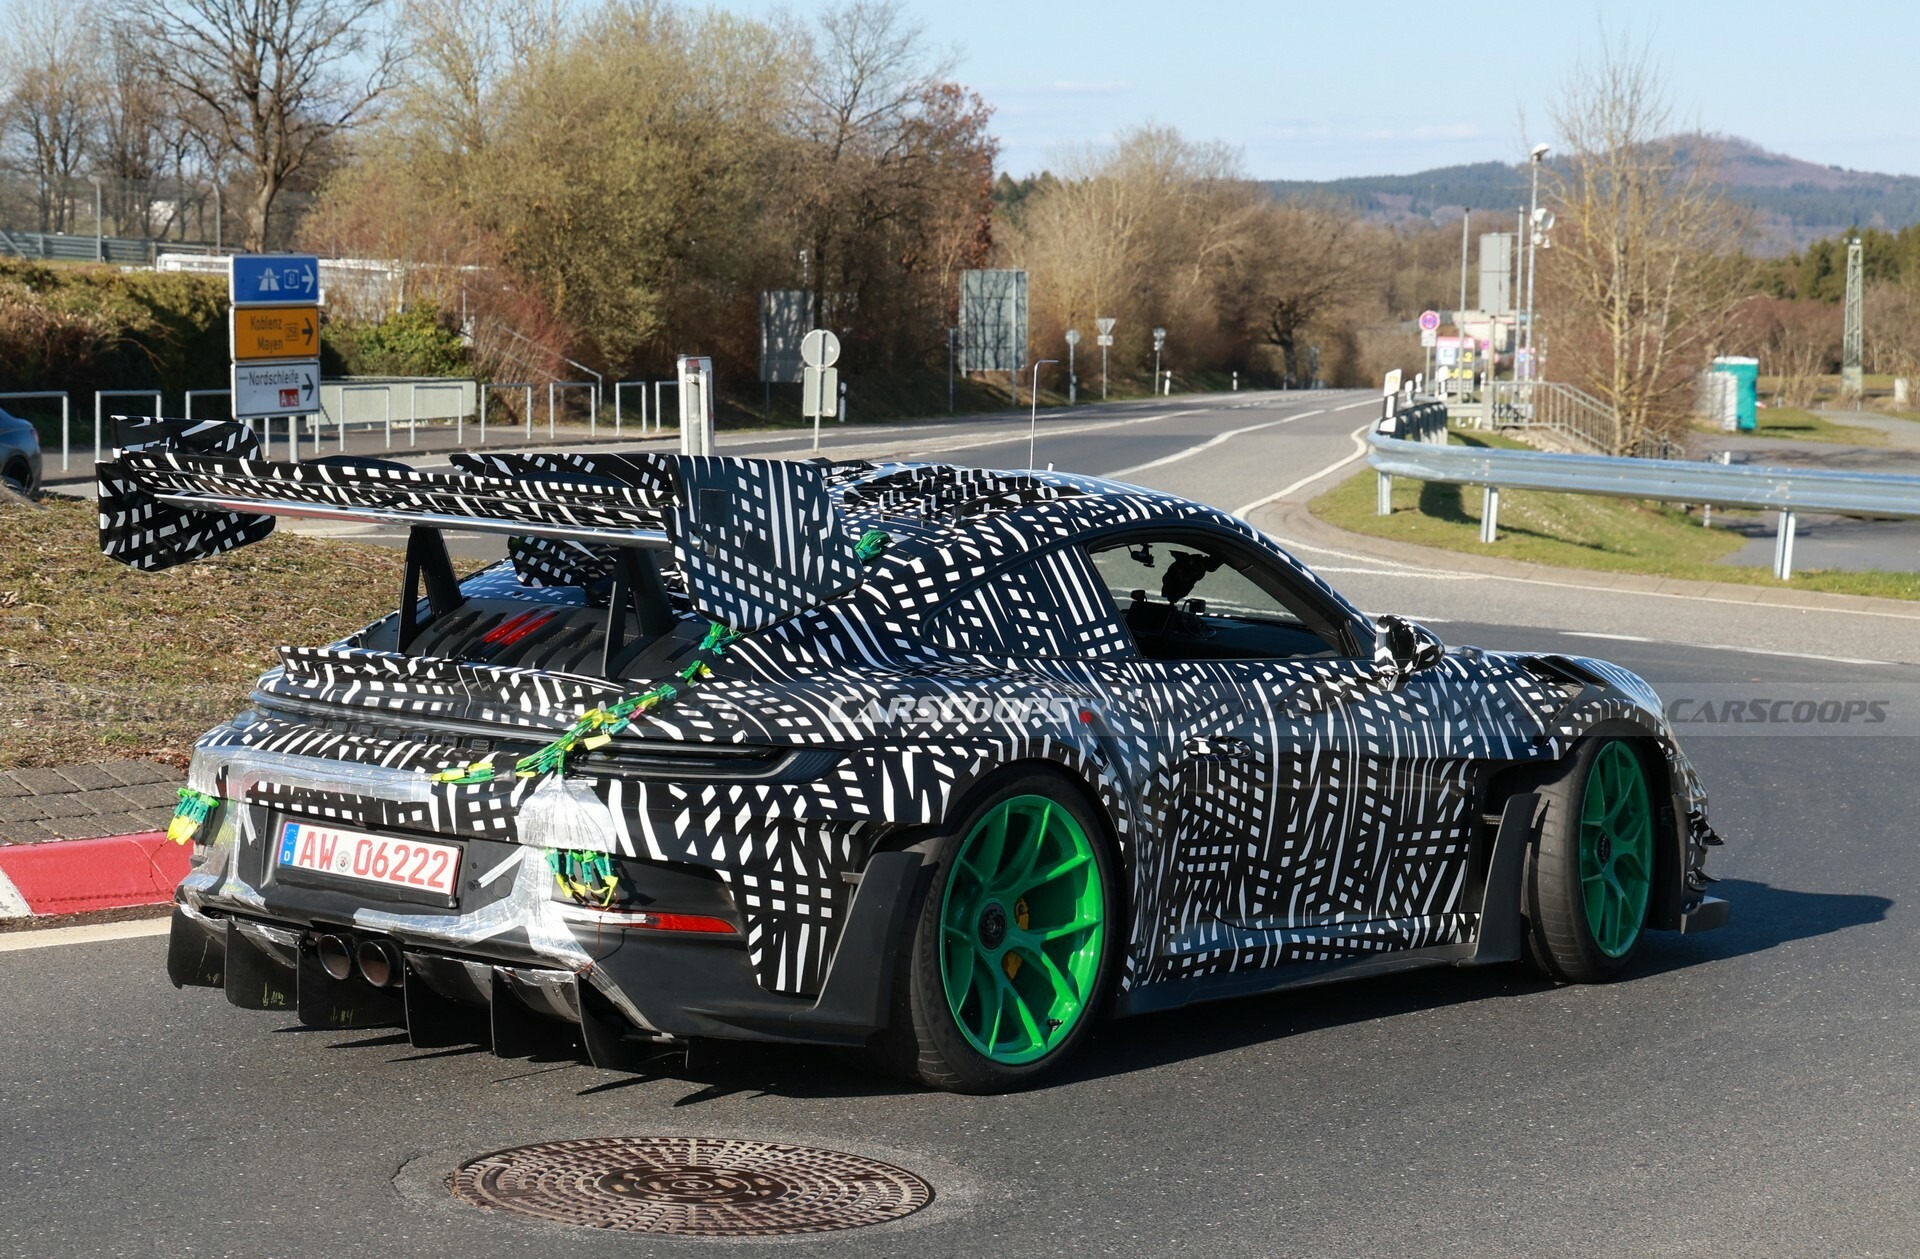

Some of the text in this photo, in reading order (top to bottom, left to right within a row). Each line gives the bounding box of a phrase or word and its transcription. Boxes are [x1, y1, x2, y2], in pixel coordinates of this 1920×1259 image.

[250, 316, 282, 330] Koblenz
[257, 336, 283, 353] Mayen
[249, 370, 299, 386] Nordschleife
[283, 850, 290, 862] D
[298, 831, 449, 889] AW 06222
